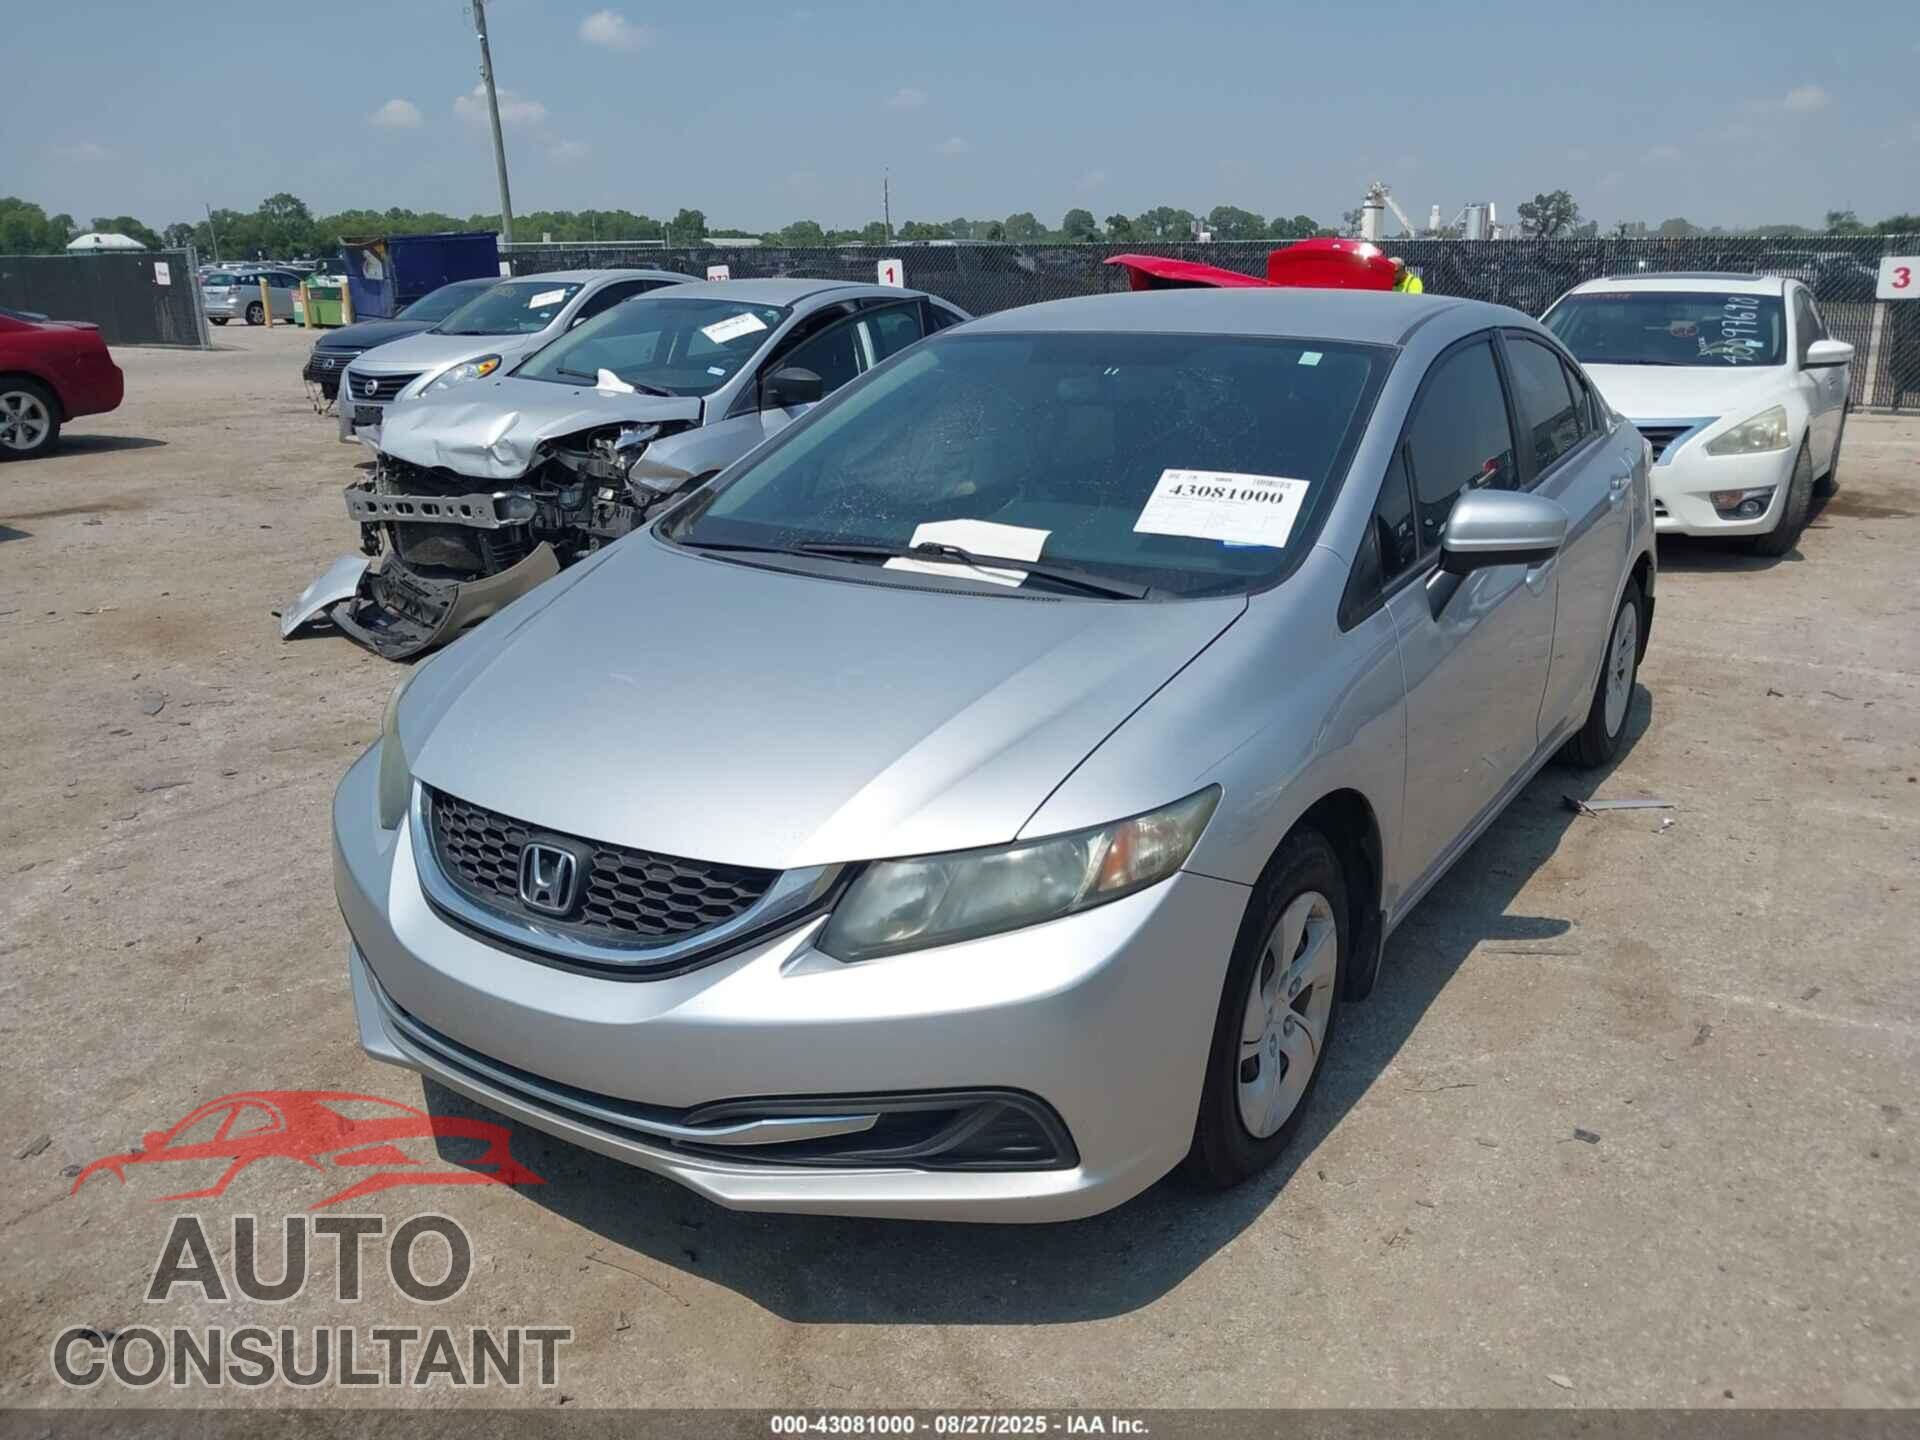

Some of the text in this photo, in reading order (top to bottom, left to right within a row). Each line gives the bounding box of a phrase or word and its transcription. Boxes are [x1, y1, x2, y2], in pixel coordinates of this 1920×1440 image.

[886, 267, 894, 283] 1
[1892, 267, 1911, 289] 3
[1168, 484, 1284, 505] 43081000
